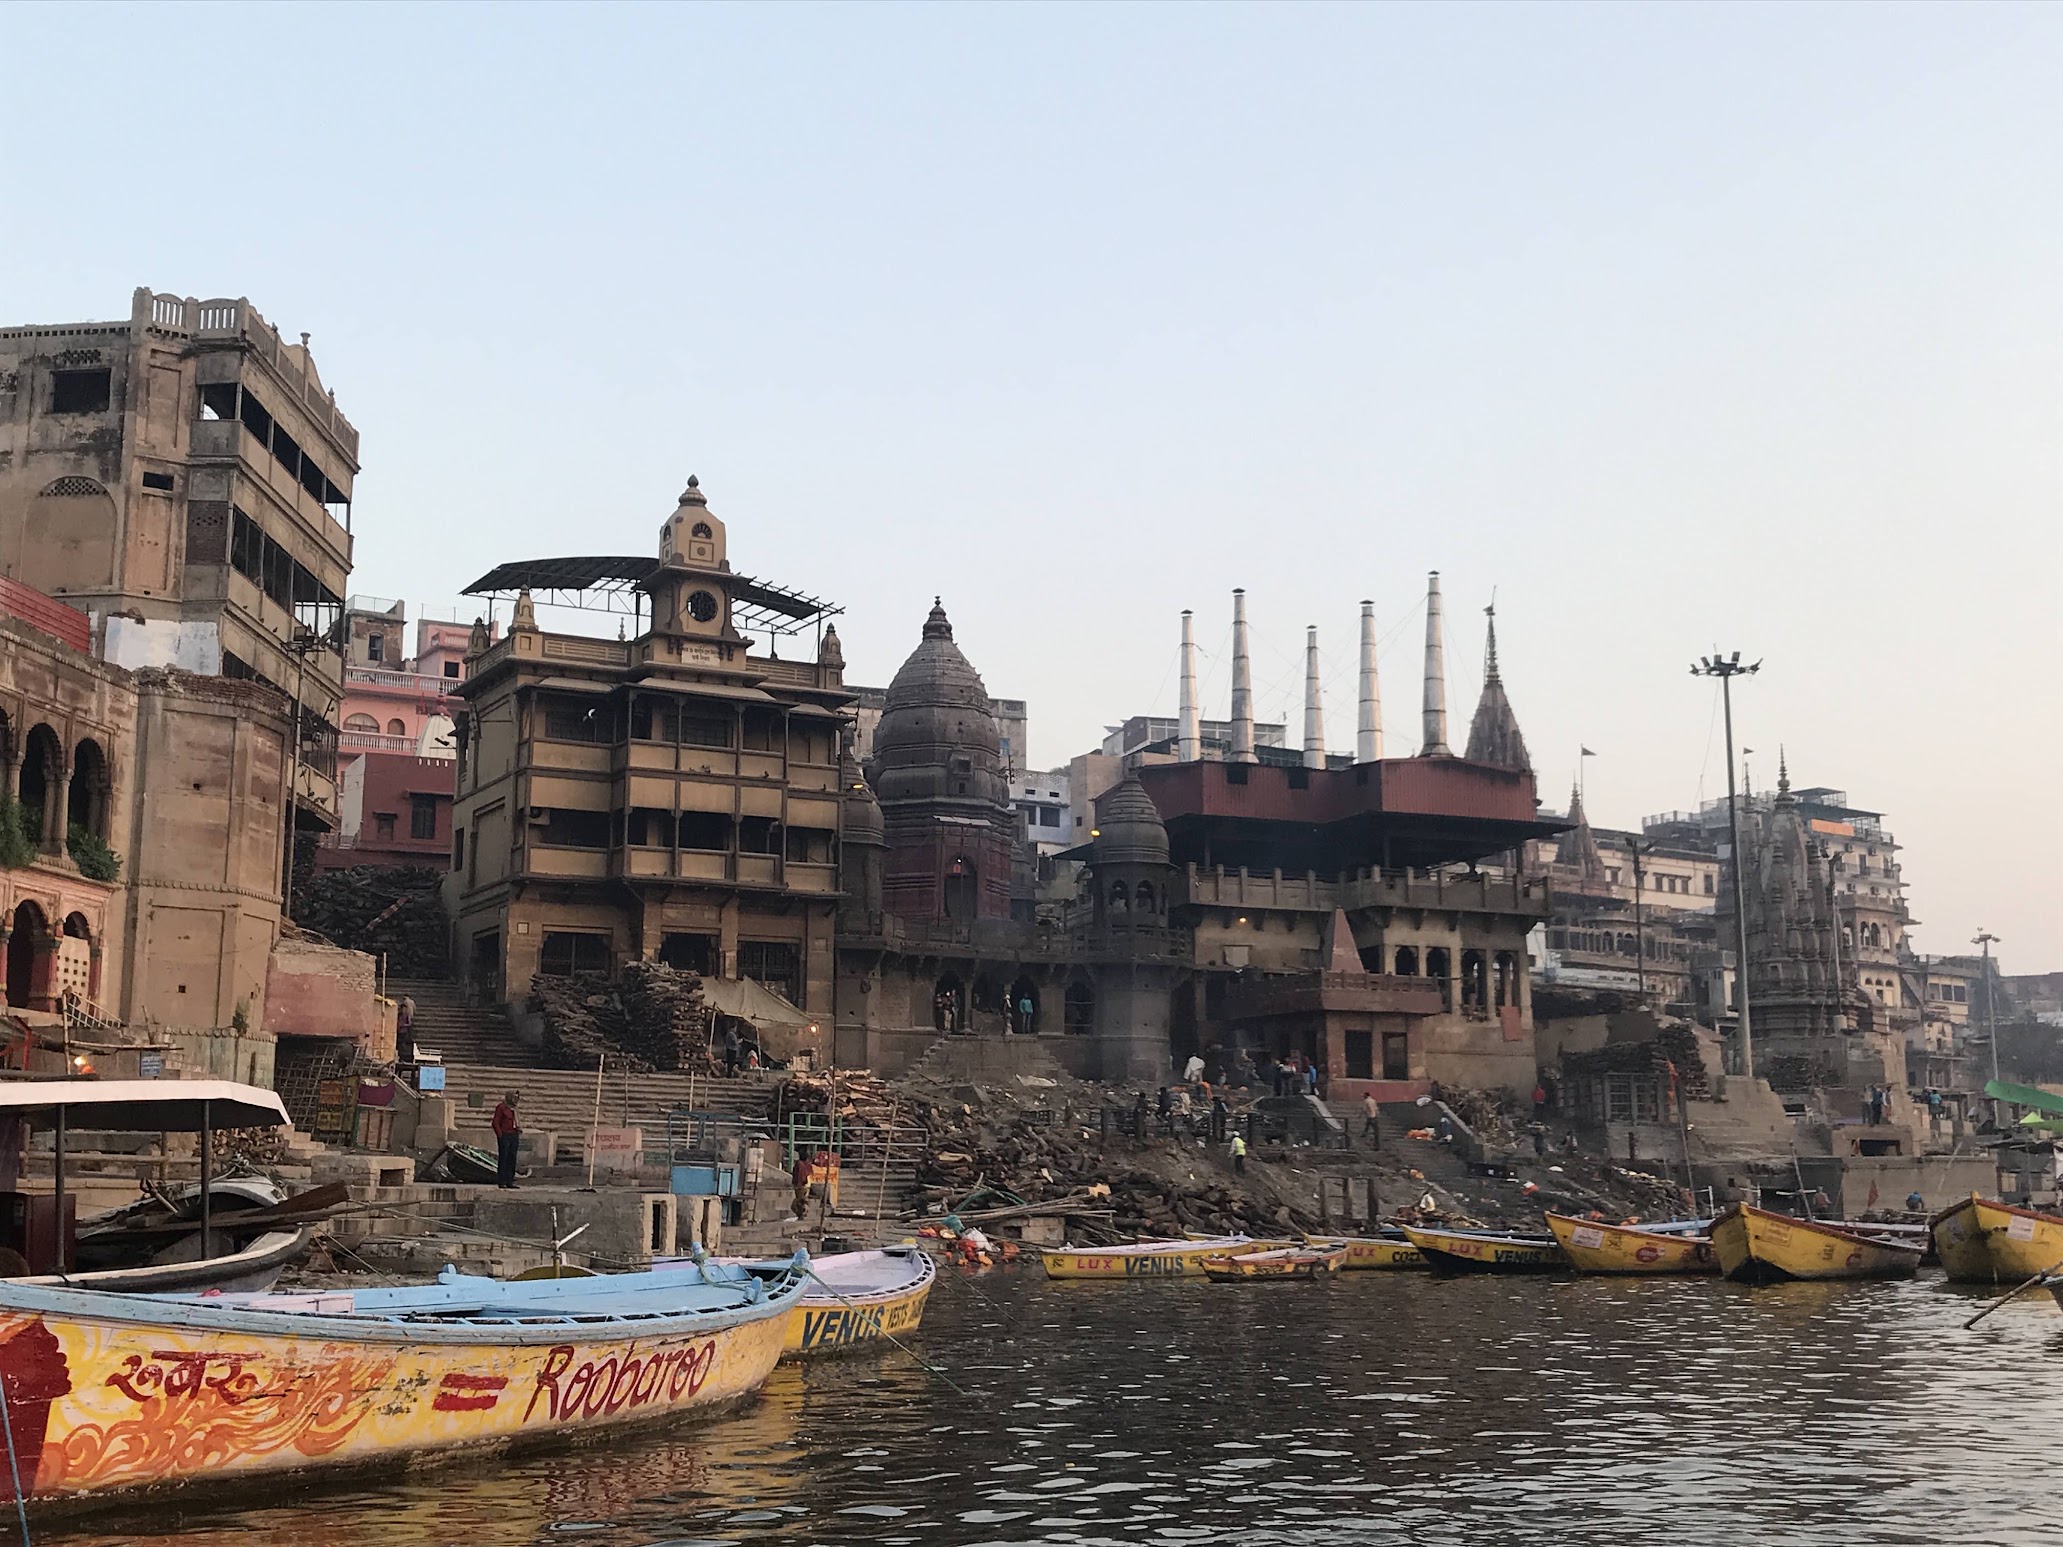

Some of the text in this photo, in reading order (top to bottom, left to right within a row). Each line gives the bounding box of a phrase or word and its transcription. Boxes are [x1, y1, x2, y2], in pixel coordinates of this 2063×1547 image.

[1077, 1258, 1113, 1270] LUX
[1124, 1255, 1184, 1275] VENUS
[1448, 1242, 1542, 1264] LUX VENUS
[801, 1305, 885, 1349] VENUS
[523, 1339, 716, 1424] Roobaroo
